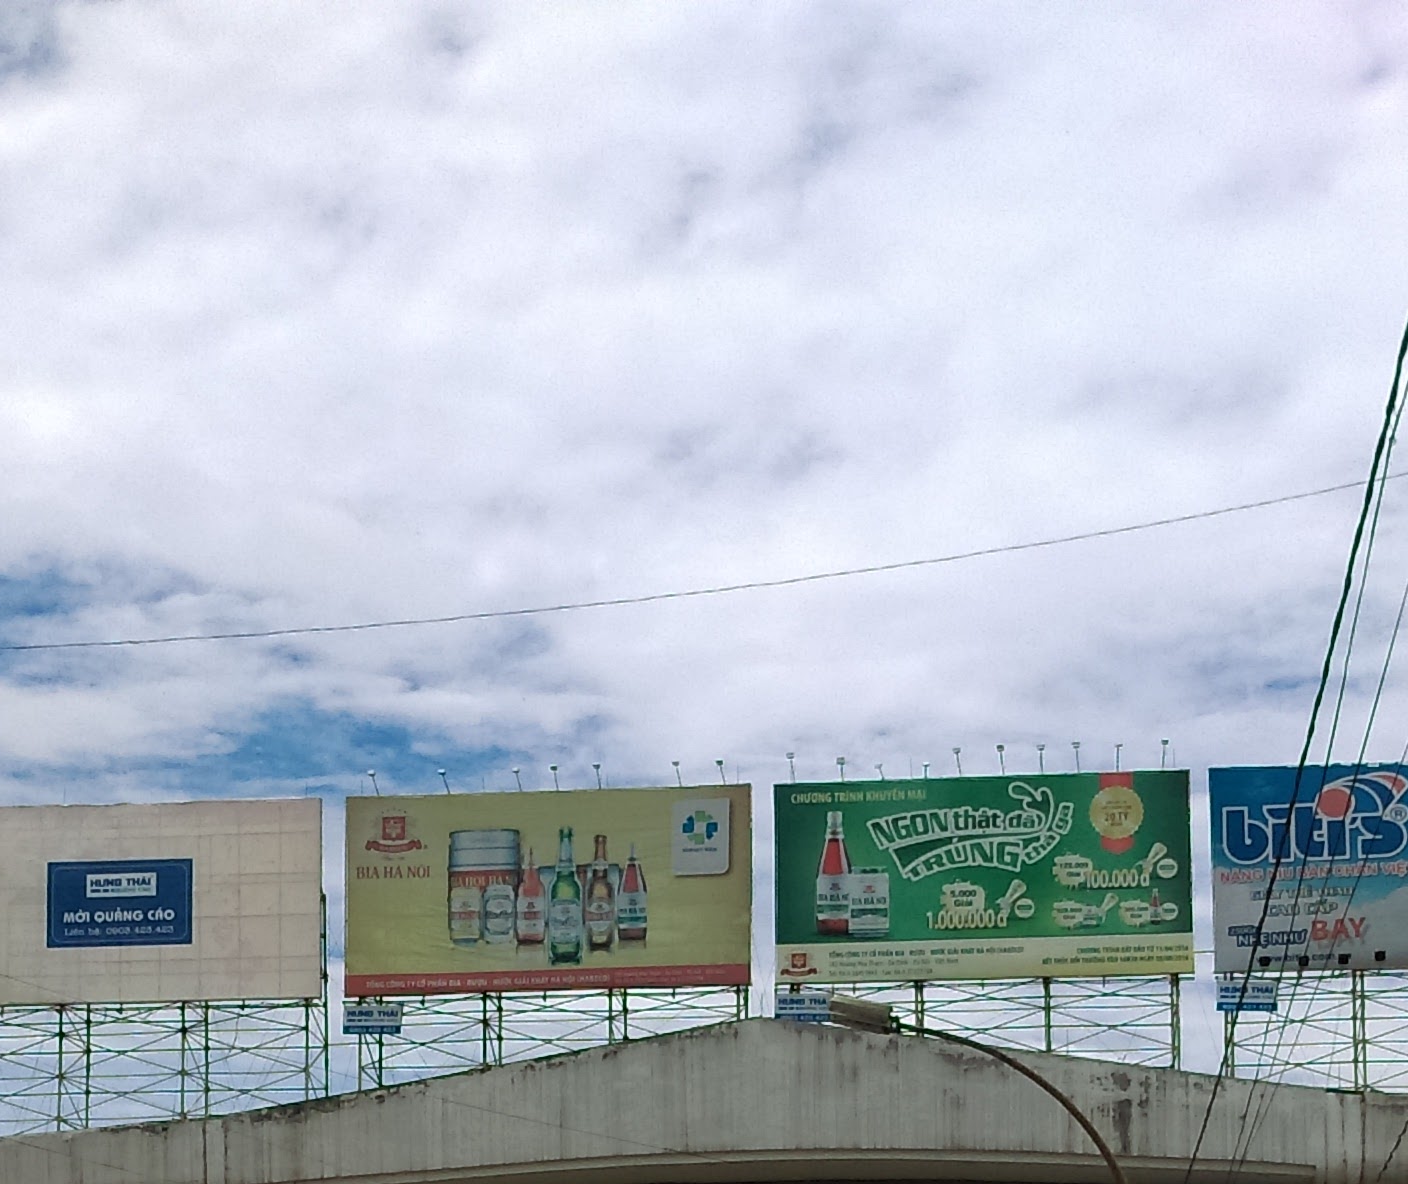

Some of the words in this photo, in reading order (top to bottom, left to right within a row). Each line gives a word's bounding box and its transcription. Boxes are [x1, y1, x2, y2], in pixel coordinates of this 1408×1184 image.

[791, 792, 831, 803] CHƯƠNG
[835, 791, 863, 802] TRÌNH
[868, 810, 949, 848] NGON
[952, 808, 999, 835] thật
[904, 837, 1022, 881] TRÚNG
[357, 866, 381, 879] BIA
[64, 909, 90, 923] MỜI
[94, 907, 143, 923] QUẢNG
[147, 907, 175, 920] CÁO
[927, 911, 996, 929] 1.000.000
[1271, 929, 1307, 944] NHƯ
[1311, 917, 1366, 941] BAY
